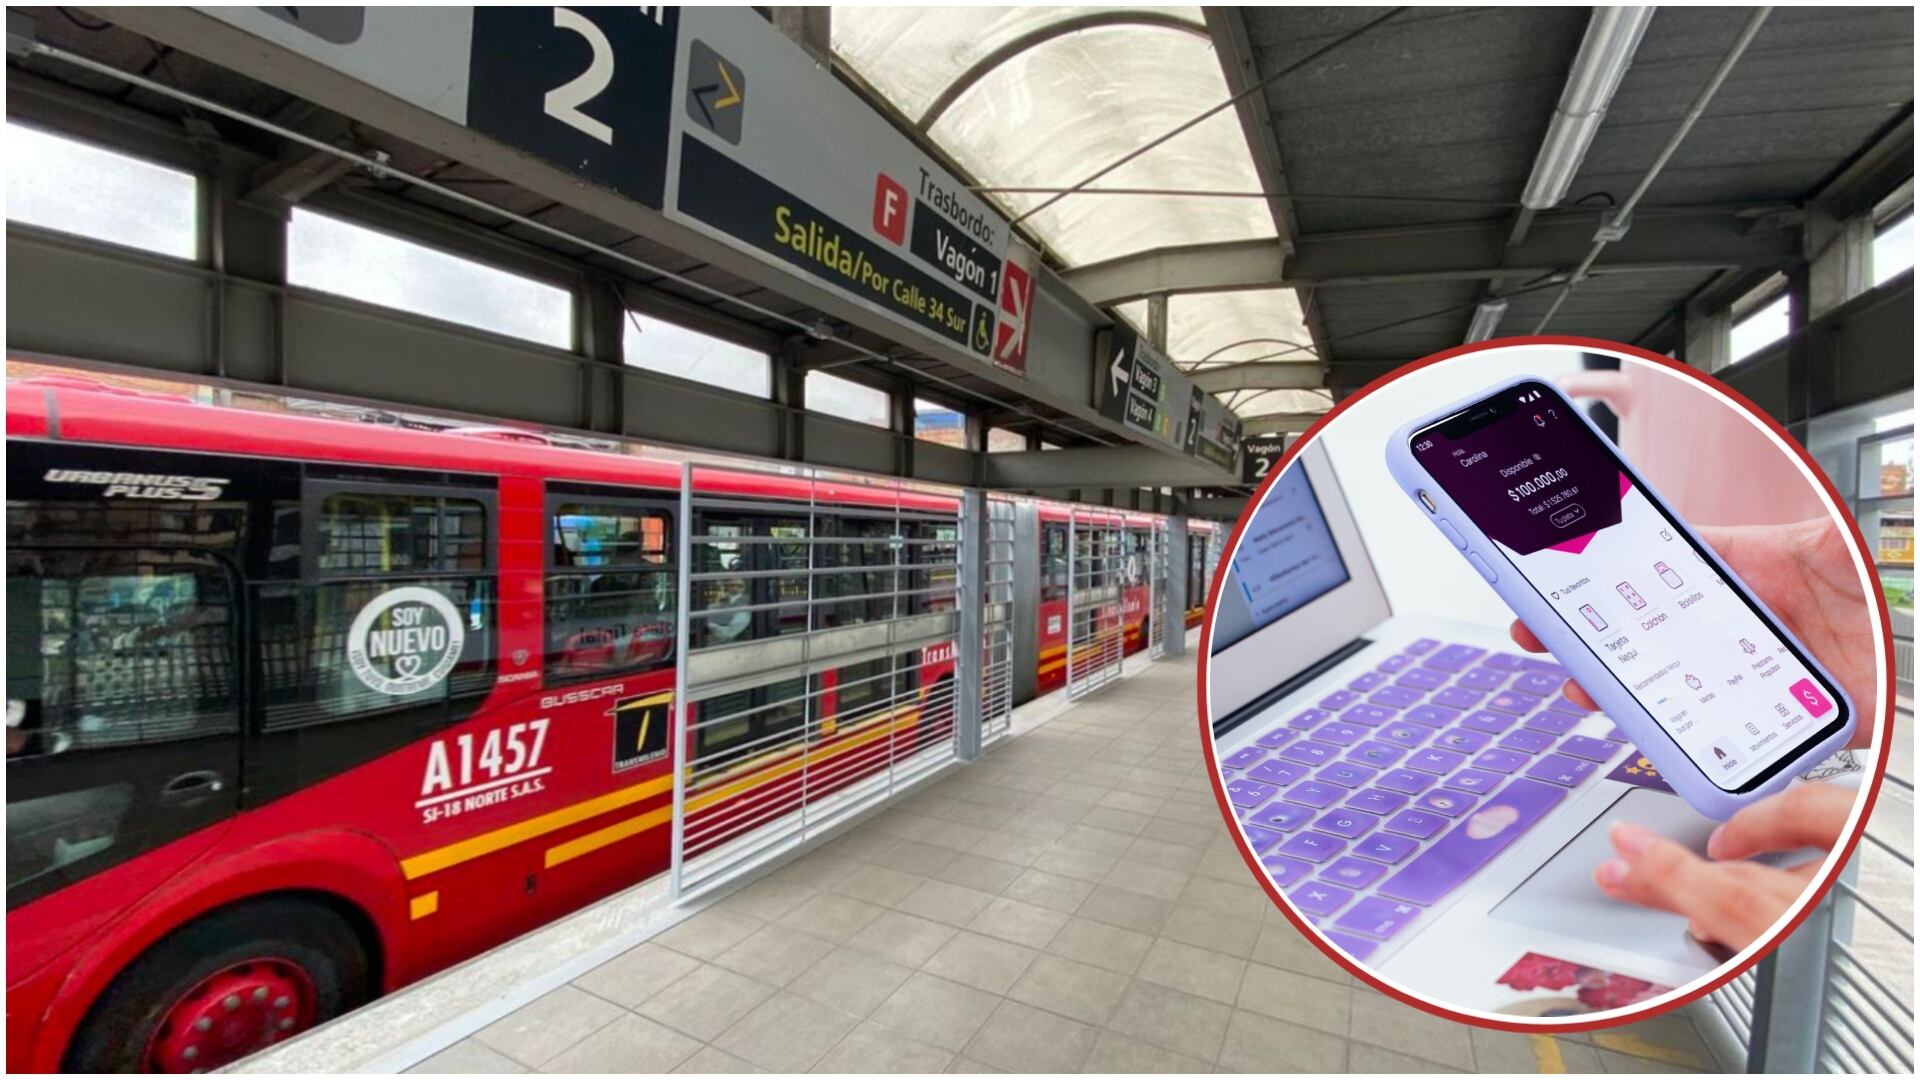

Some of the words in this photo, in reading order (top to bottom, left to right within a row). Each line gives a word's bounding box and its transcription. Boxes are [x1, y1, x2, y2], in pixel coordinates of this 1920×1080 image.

[544, 6, 615, 146] 2
[882, 187, 899, 228] F
[918, 167, 995, 246] Trasbordo:
[935, 228, 986, 288] Vagón
[990, 270, 998, 296] 1
[892, 279, 926, 313] Calle
[928, 298, 944, 321] 34
[946, 305, 967, 332] Sur
[1247, 443, 1281, 455] Vagón
[1459, 451, 1489, 468] Carolina
[1254, 457, 1271, 478] 2
[1499, 458, 1534, 478] Disponible
[391, 606, 424, 627] SOY
[370, 626, 445, 658] NUEVO
[1604, 635, 1630, 652] Tarjeta
[421, 717, 551, 796] A1457
[464, 786, 509, 812] NORTE
[510, 778, 546, 799] S.A.S.
